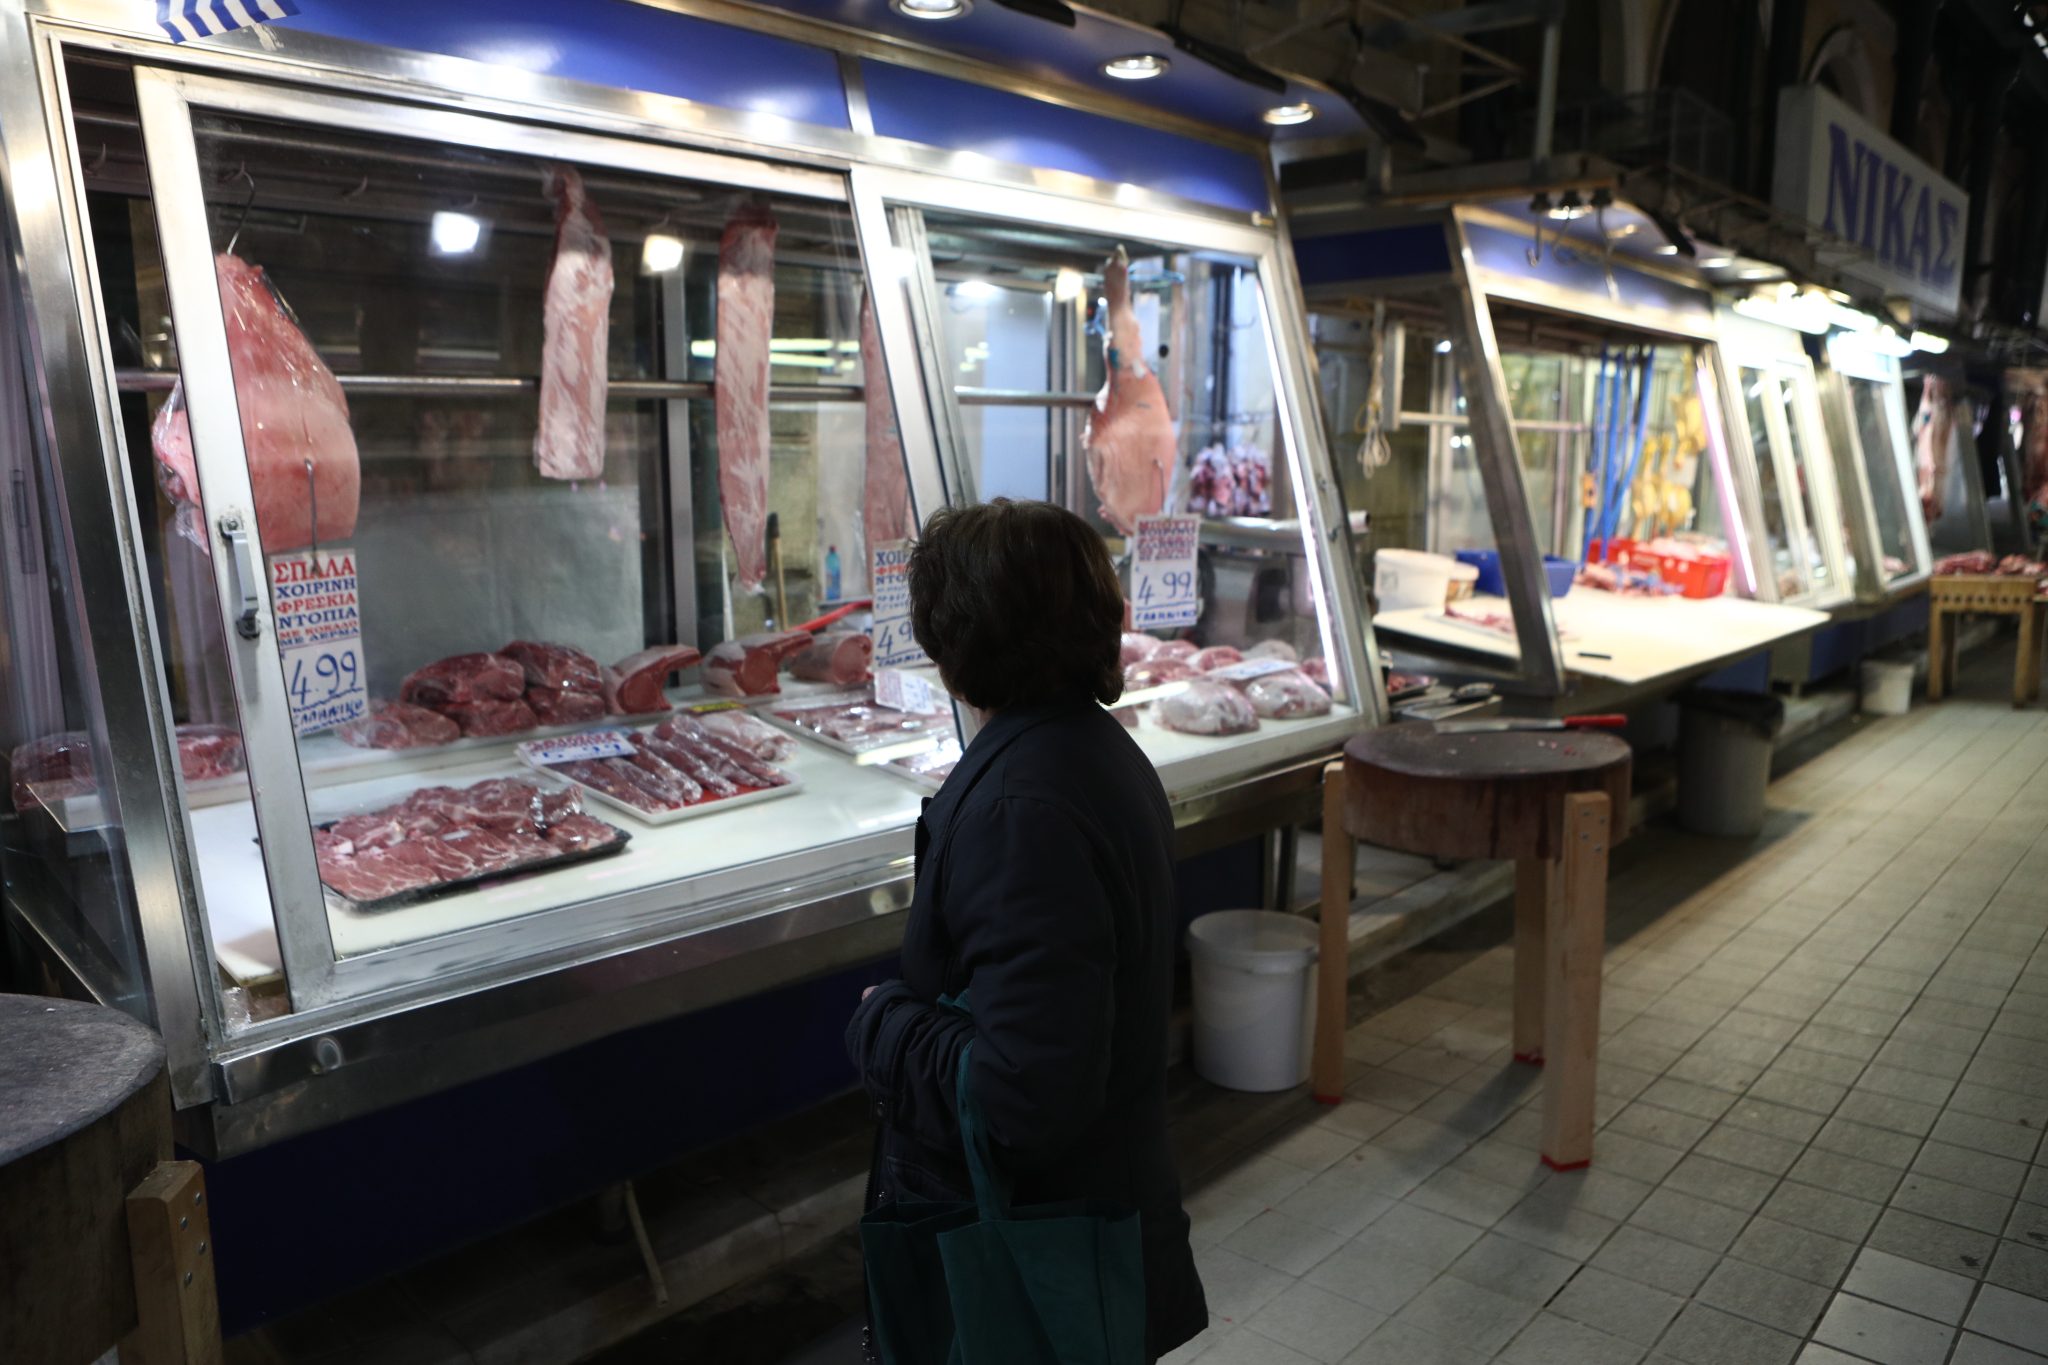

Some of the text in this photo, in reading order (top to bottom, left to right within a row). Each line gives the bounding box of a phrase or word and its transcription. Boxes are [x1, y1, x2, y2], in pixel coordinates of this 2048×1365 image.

[1824, 122, 1959, 288] ΝΙΚΑΣ
[274, 557, 355, 583] ΣΠΑΛΑ
[276, 577, 357, 599] ΧΟΙΡΙΝΗ
[277, 591, 357, 614] ΦΡΕΣΚΙΑ
[278, 606, 358, 629] ΝΤΟΠΙΑ
[291, 650, 357, 705] 4.99
